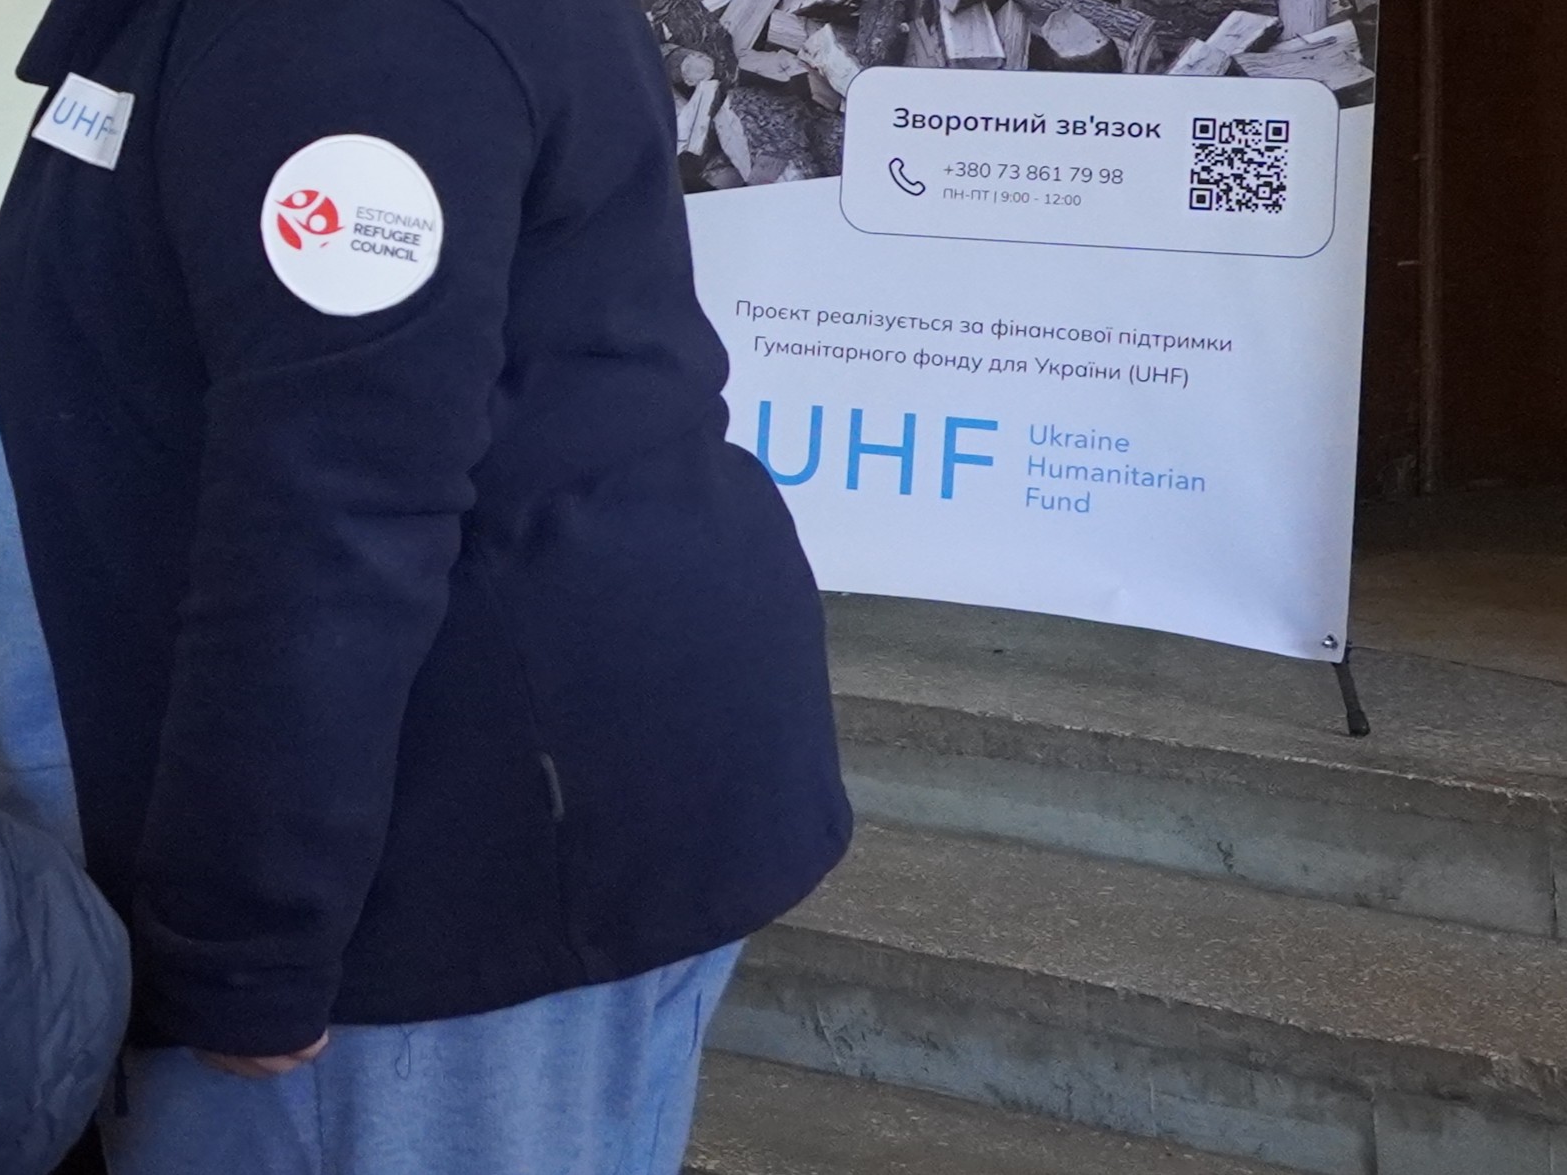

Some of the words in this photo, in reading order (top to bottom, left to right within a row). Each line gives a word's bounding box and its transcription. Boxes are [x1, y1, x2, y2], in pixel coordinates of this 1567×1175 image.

[52, 97, 117, 140] UHF
[892, 107, 1046, 136] Зворотний
[1056, 115, 1162, 139] зв'язок
[943, 162, 991, 179] +380
[997, 164, 1021, 180] 73
[1026, 165, 1062, 182] 861
[1069, 167, 1093, 183] 79
[1098, 168, 1124, 184] 98
[943, 188, 989, 202] ПН-ПТ
[1001, 191, 1030, 204] 9:00
[1045, 193, 1082, 206] 12:00
[353, 222, 421, 246] REFUGEE
[356, 206, 433, 232] ESTONIAN
[350, 239, 418, 263] COUNCIL
[736, 300, 811, 321] Проєкт
[817, 309, 953, 332] реалізується
[960, 320, 983, 334] за
[991, 319, 1112, 344] фінансової
[1119, 329, 1232, 352] підтримки
[754, 336, 906, 363] Гуманітарного
[913, 348, 983, 373] фонду
[988, 358, 1027, 374] для
[1035, 356, 1121, 380] України
[1129, 365, 1189, 389] (UHF)
[756, 400, 998, 500] UHF
[1029, 424, 1130, 454] Ukraine
[1027, 455, 1206, 493] Humanitarian
[1025, 487, 1091, 514] Fund
